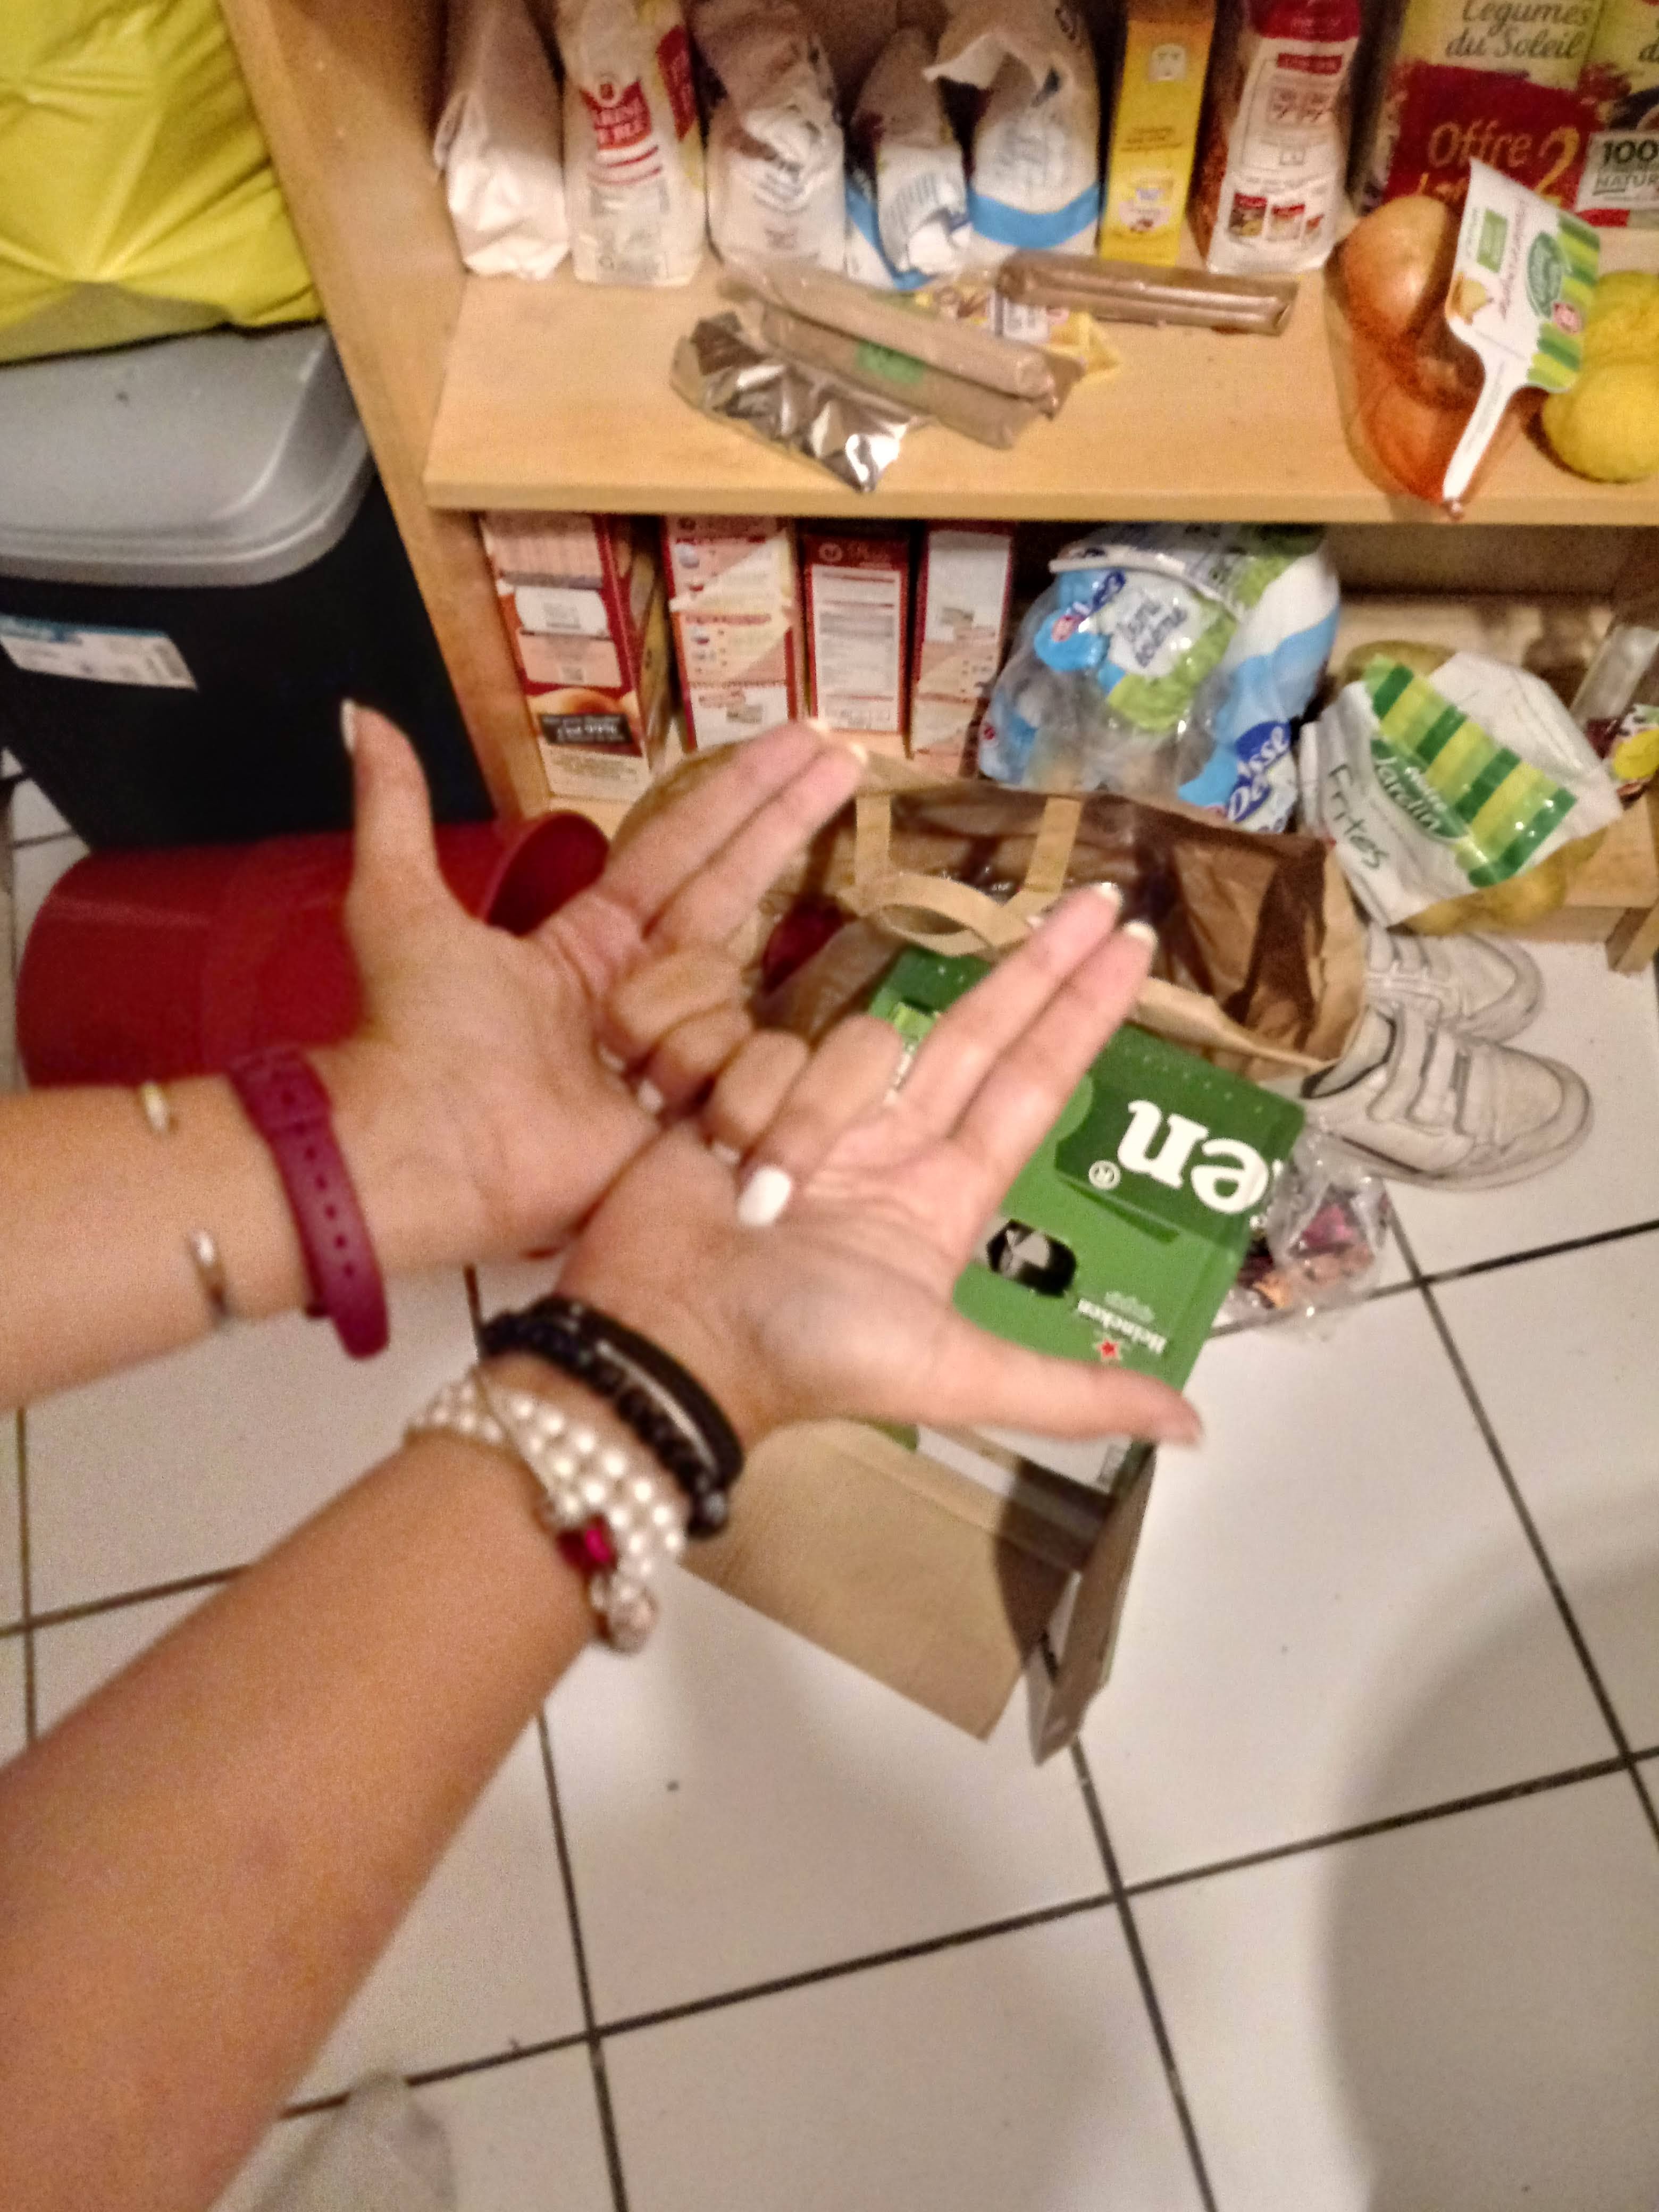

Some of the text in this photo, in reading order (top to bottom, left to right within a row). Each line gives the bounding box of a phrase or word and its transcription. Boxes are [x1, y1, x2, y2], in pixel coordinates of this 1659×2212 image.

[1445, 24, 1586, 59] du Soleil
[1428, 120, 1533, 169] Offre
[1595, 171, 1659, 189] NATUR
[1328, 763, 1389, 869] Frites
